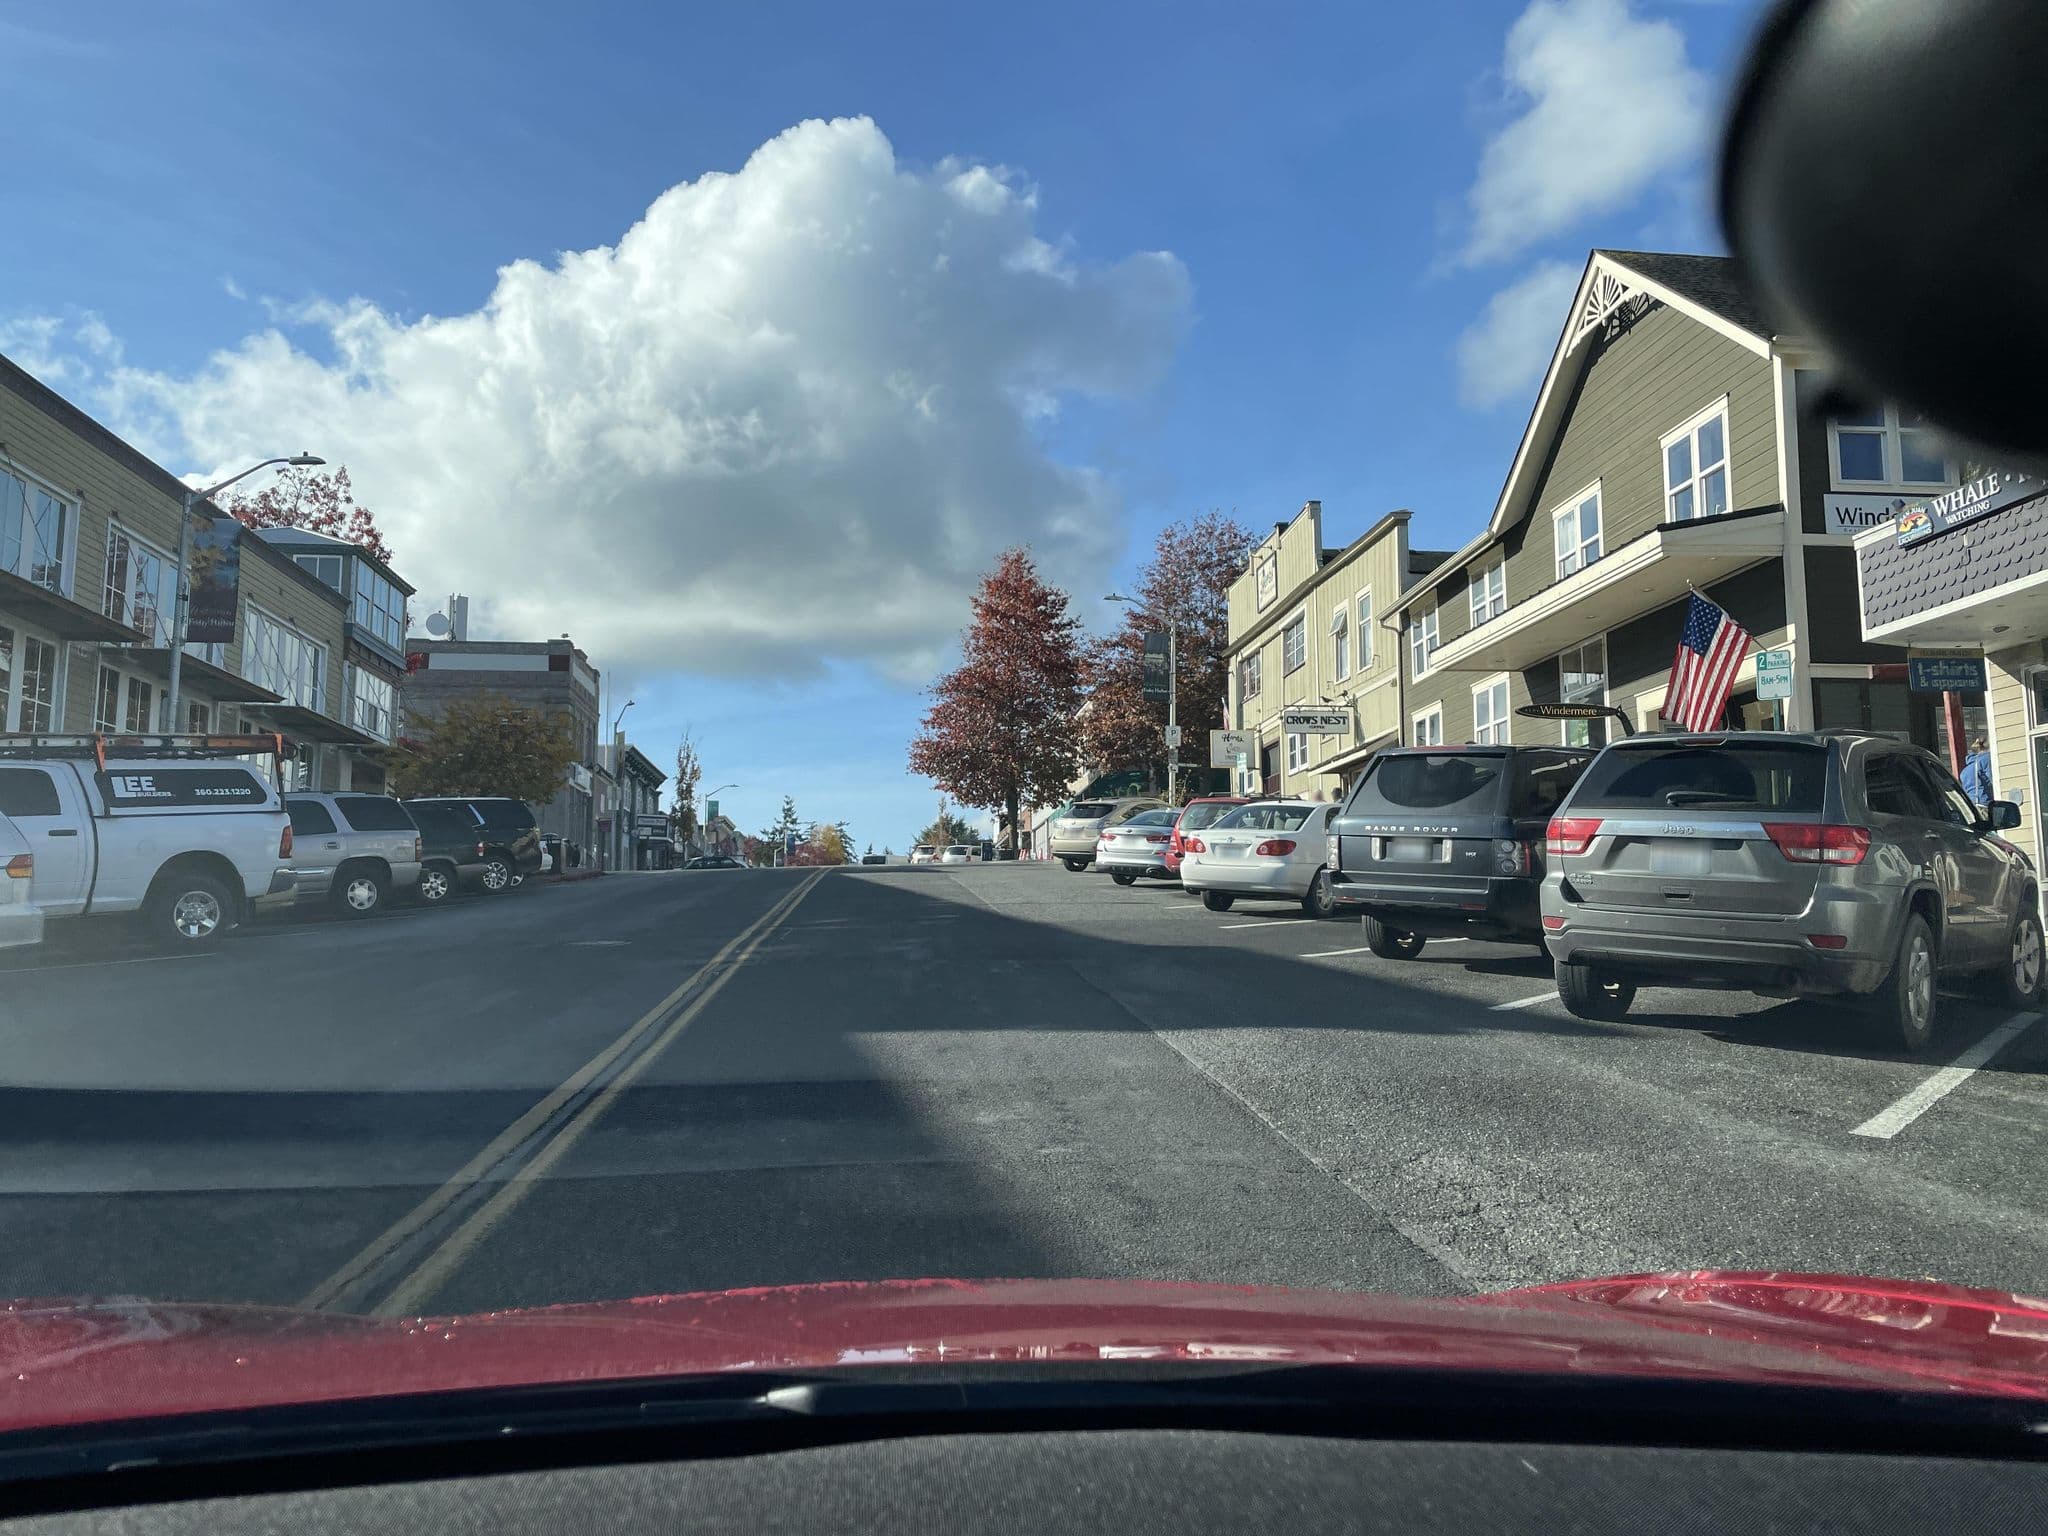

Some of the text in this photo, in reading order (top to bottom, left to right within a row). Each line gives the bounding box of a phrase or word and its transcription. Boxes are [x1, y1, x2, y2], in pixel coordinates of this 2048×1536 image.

[1932, 473, 2001, 518] WHALE
[1945, 500, 1990, 525] WATCHING
[1759, 655, 1766, 668] 2
[1767, 659, 1789, 667] PARKING
[1917, 660, 1979, 676] t-shirts
[1760, 674, 1789, 685] 8AM-5PM
[1540, 705, 1598, 716] Windermere
[1286, 716, 1348, 725] CROWS NEST
[111, 776, 156, 798] LEE
[194, 788, 251, 796] 360.223.1220
[1662, 823, 1695, 836] Jeep
